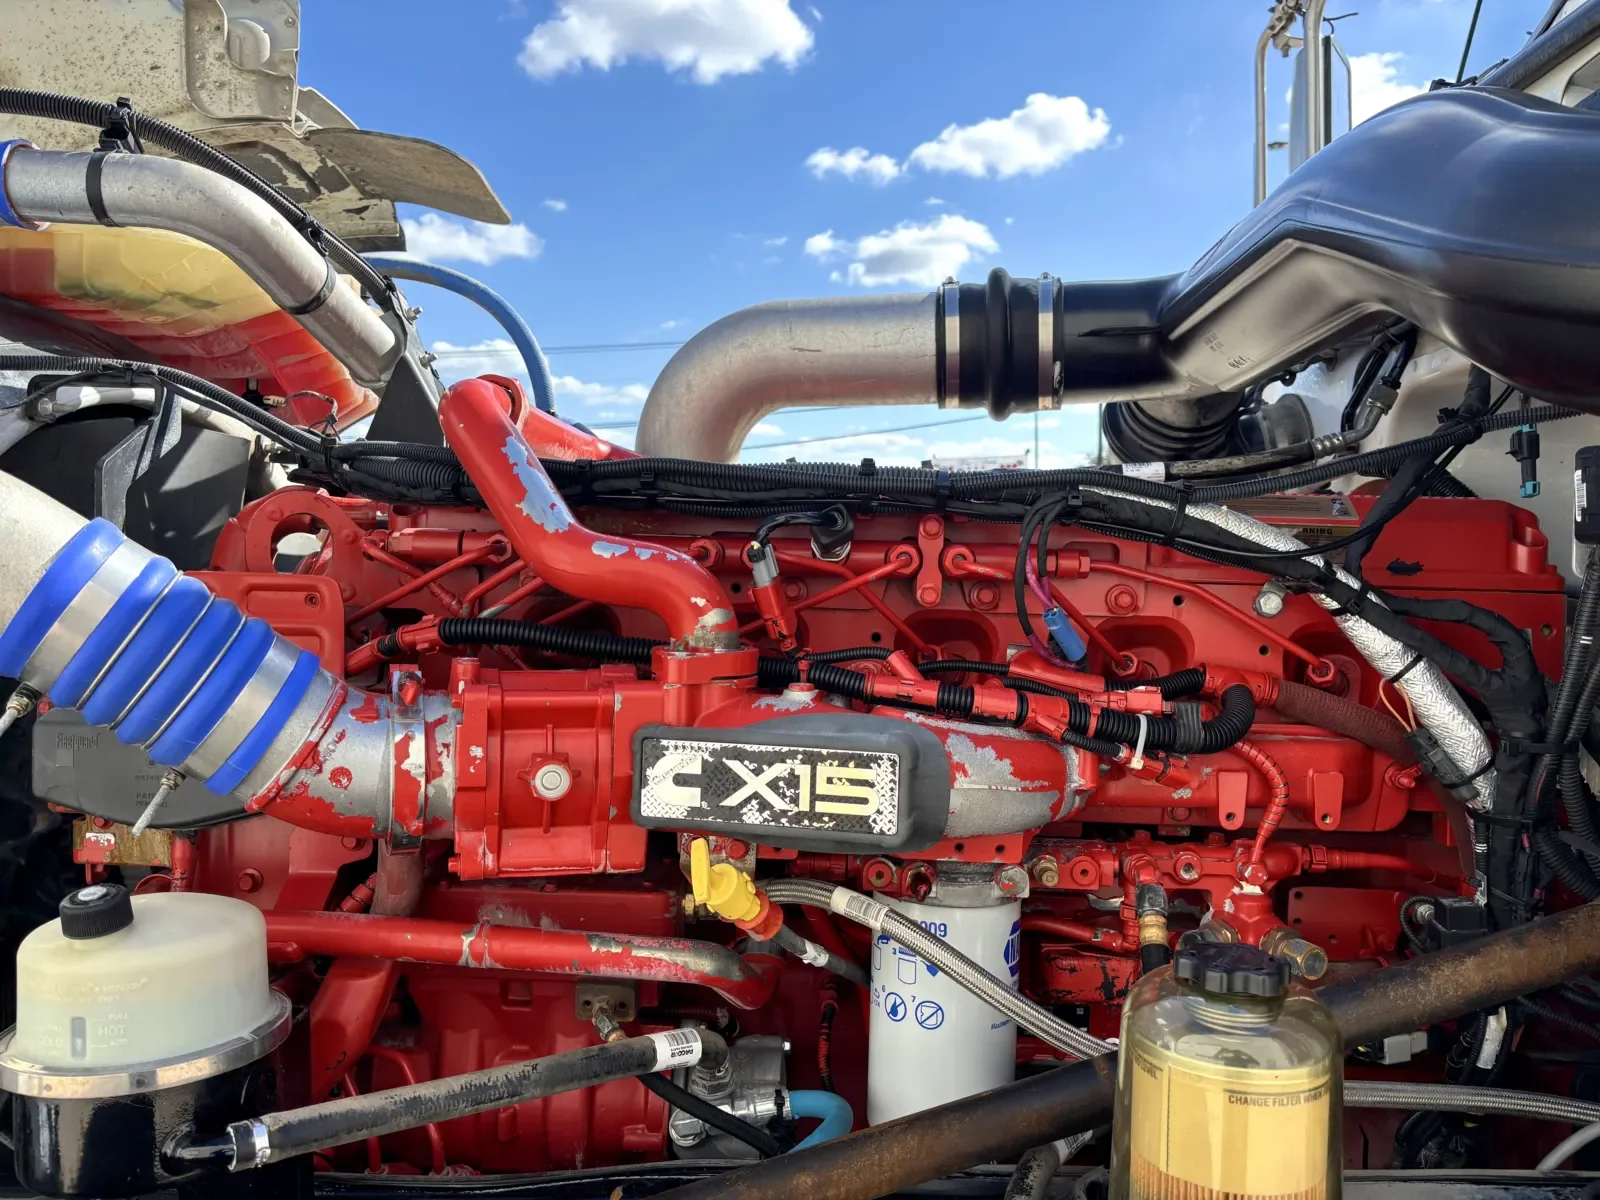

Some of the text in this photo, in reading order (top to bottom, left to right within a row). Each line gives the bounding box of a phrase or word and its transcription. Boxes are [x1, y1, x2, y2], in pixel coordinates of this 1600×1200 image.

[1301, 527, 1333, 535] RNING
[719, 757, 881, 817] X15
[892, 947, 897, 955] 3
[910, 995, 916, 1003] 7
[98, 1024, 127, 1037] HOT
[1228, 1094, 1270, 1107] CHANGE
[1272, 1094, 1302, 1107] FILTER
[1303, 1090, 1322, 1104] WHEN
